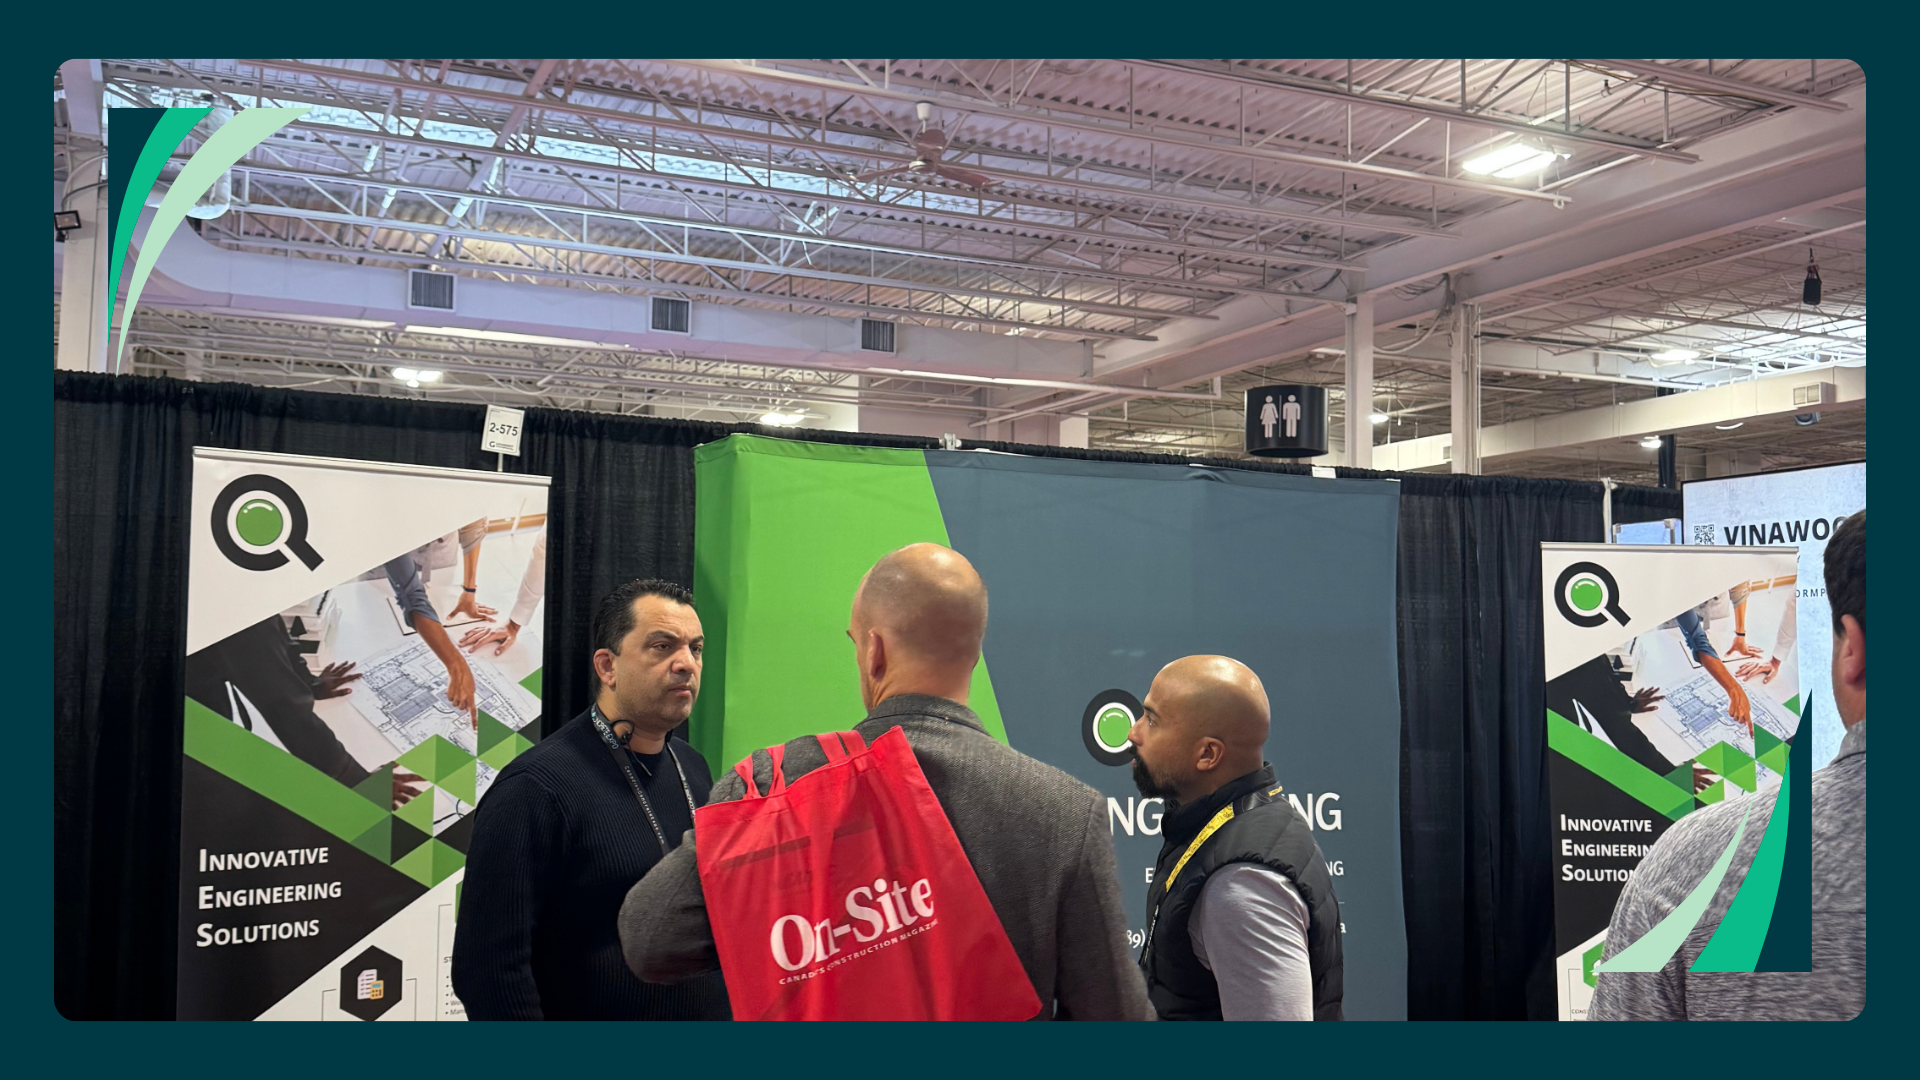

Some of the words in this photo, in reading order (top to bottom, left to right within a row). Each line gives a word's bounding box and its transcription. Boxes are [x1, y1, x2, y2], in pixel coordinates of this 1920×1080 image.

[489, 422, 519, 437] 2-575
[1796, 588, 1827, 599] ORMP
[1560, 813, 1653, 833] INNOVATIVE
[1561, 838, 1654, 857] ENGINEERIN
[199, 847, 329, 872] INNOVATIVE
[198, 881, 342, 910] ENGINEERING
[195, 919, 320, 948] SOLUTIONS
[770, 878, 934, 971] On-Site
